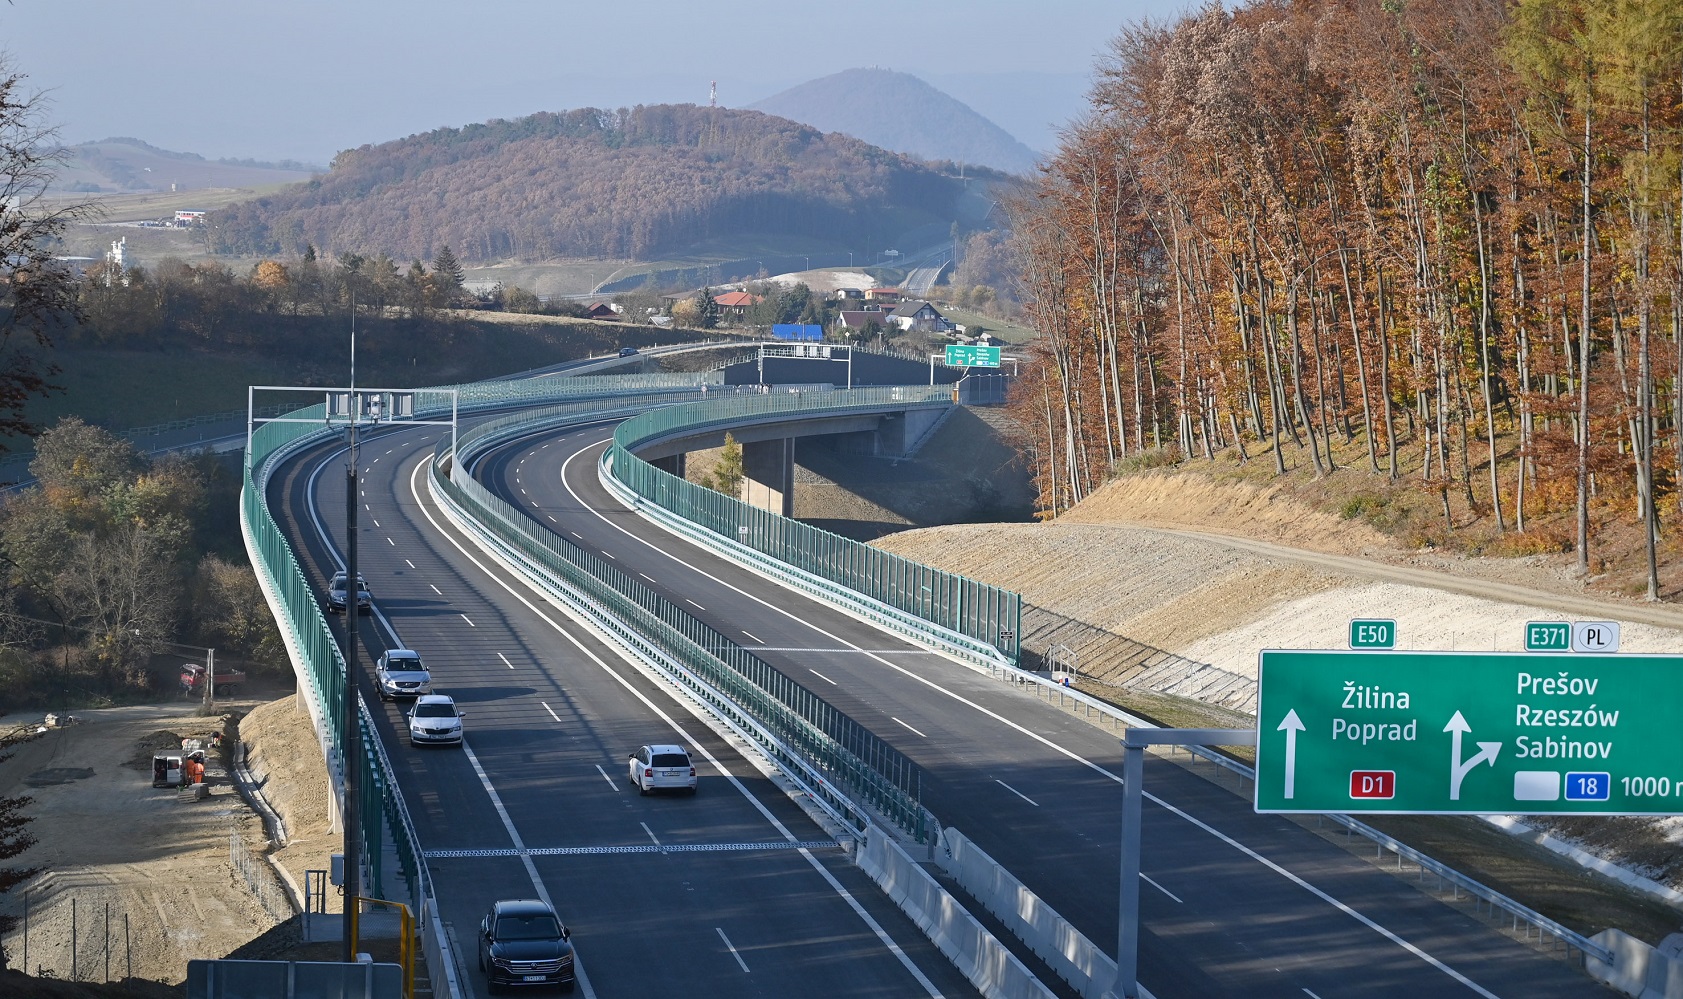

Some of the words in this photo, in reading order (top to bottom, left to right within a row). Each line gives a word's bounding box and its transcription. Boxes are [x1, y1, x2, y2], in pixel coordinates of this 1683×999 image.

[1358, 625, 1388, 643] E50
[1531, 627, 1566, 646] E371
[1587, 628, 1605, 646] PL
[1517, 671, 1599, 696] Prešov
[1341, 680, 1410, 710] Žilina
[1516, 703, 1620, 727] Rzeszów
[1332, 718, 1417, 746] Poprad
[1515, 735, 1613, 759] Sabinov
[1361, 775, 1383, 794] D1
[1577, 777, 1598, 795] 18
[1620, 776, 1671, 797] 1000
